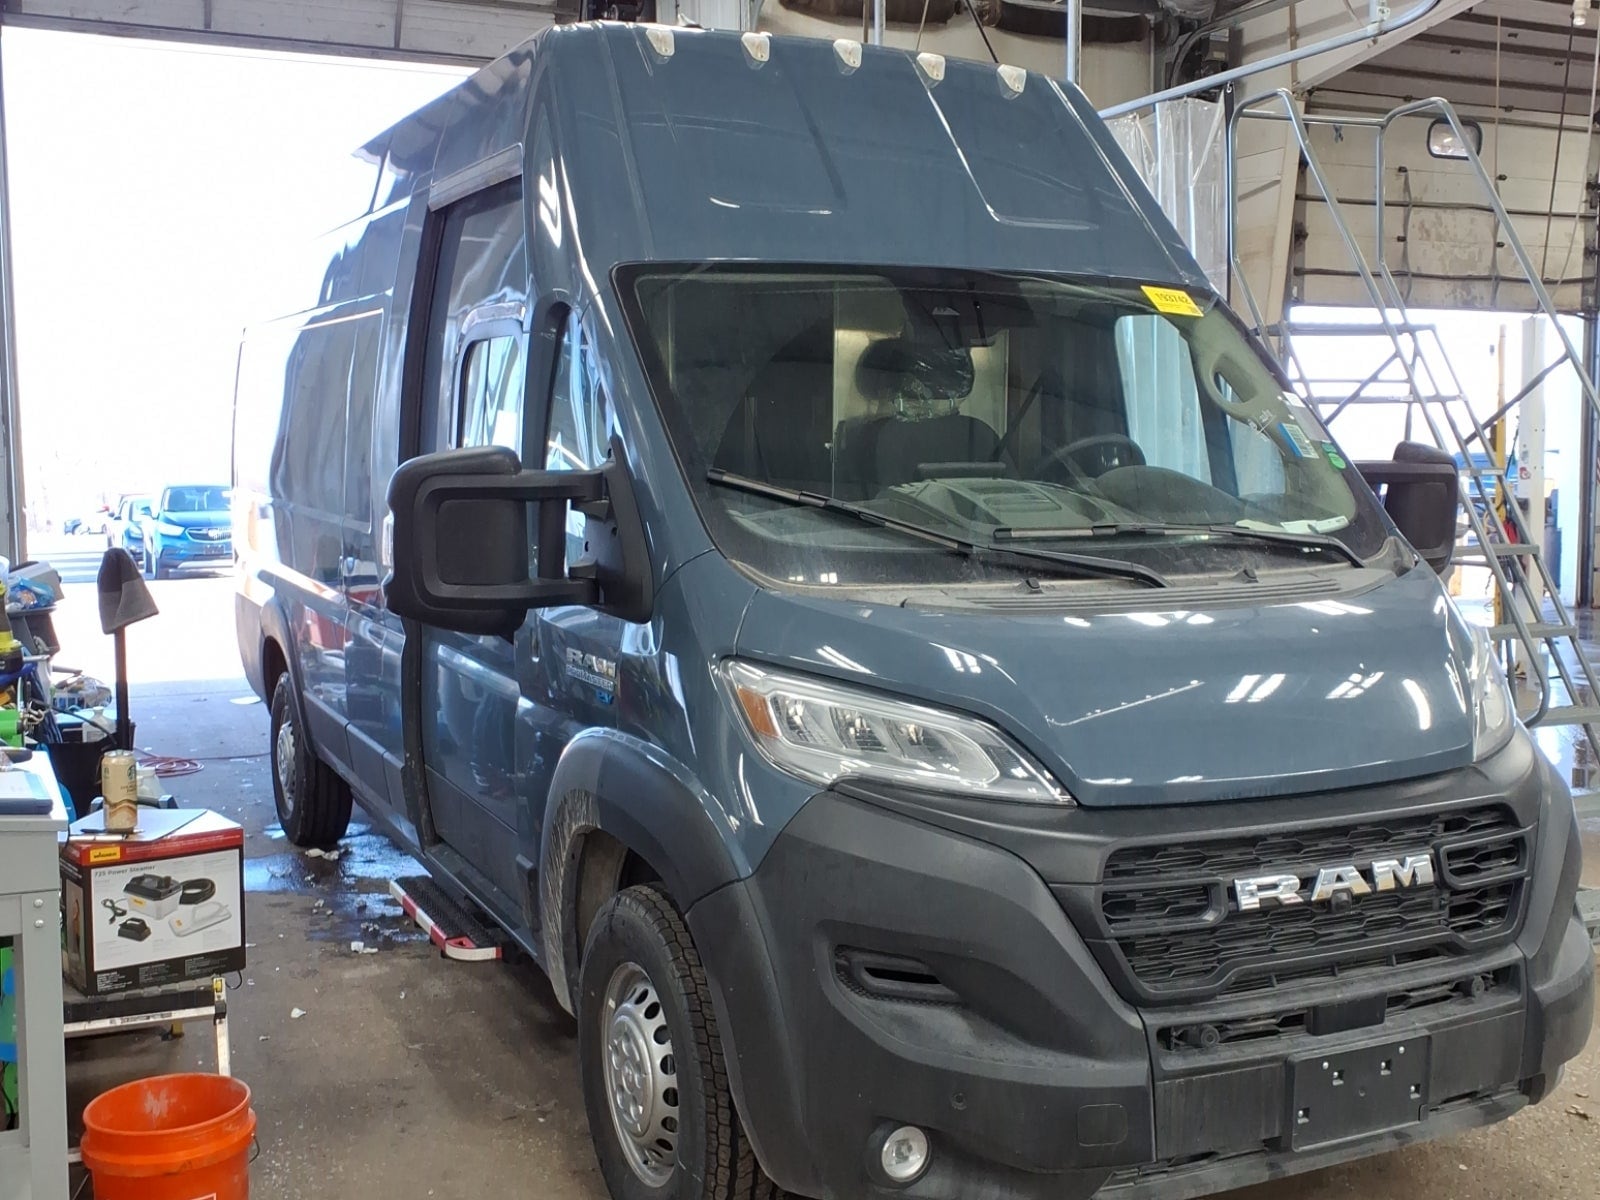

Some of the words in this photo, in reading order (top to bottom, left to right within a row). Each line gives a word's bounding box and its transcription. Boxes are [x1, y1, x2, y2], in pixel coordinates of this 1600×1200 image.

[566, 647, 617, 678] RAM
[107, 868, 128, 876] Power
[129, 865, 156, 873] Steamer
[1233, 854, 1435, 911] RAM
